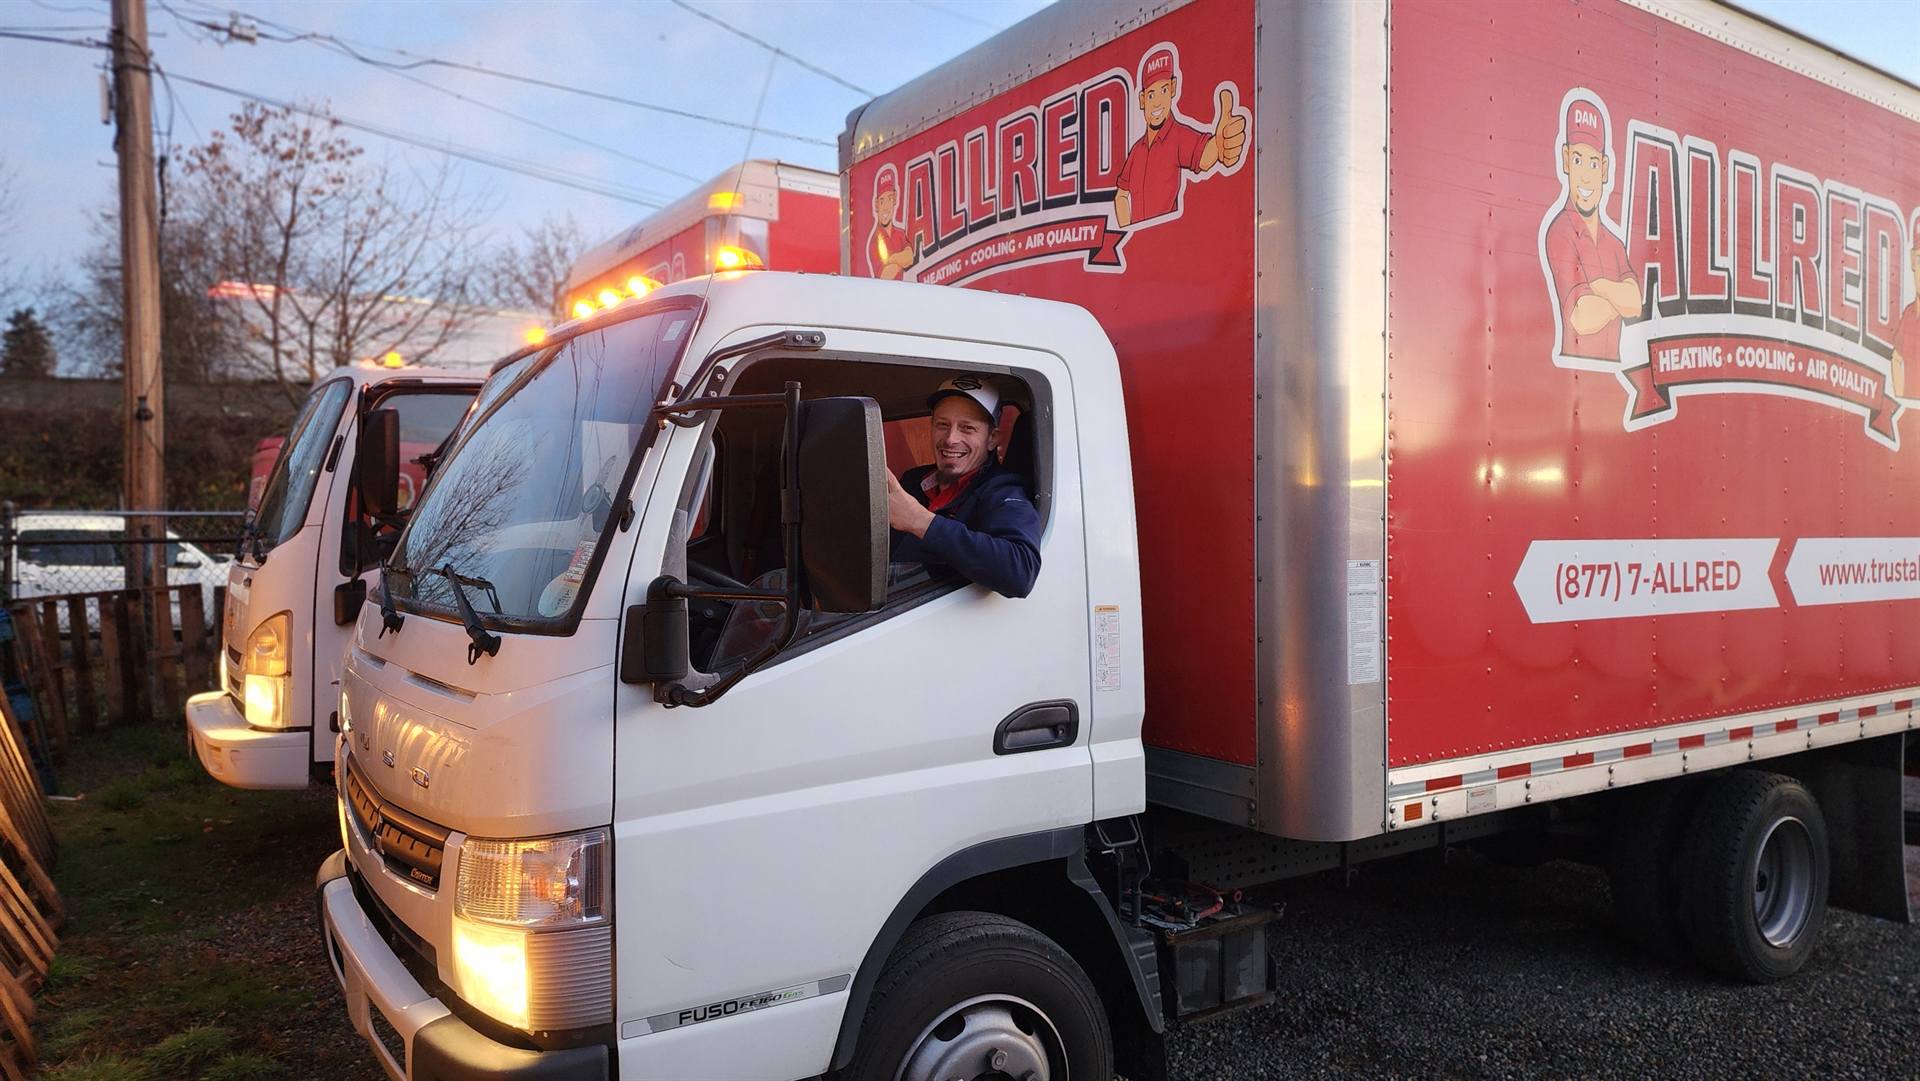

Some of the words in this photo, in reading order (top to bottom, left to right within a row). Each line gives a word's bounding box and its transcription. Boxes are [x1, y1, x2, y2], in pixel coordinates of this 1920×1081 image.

[1147, 55, 1169, 73] MATT
[1575, 108, 1597, 129] DAN
[904, 74, 1129, 266] ALLRED
[923, 259, 962, 284] HEATING
[970, 239, 1016, 266] COOLING
[1025, 232, 1045, 250] AIR
[1046, 225, 1098, 247] QUALITY
[1624, 131, 1905, 358] ALLRED
[1658, 345, 1722, 373] HEATING
[1735, 346, 1796, 373] COOLING
[1806, 357, 1828, 380] AIR
[1829, 366, 1878, 399] QUALITY
[1555, 561, 1622, 605] (877)
[1627, 560, 1742, 596] 7-ALLRED
[679, 1000, 738, 1026] FUSO
